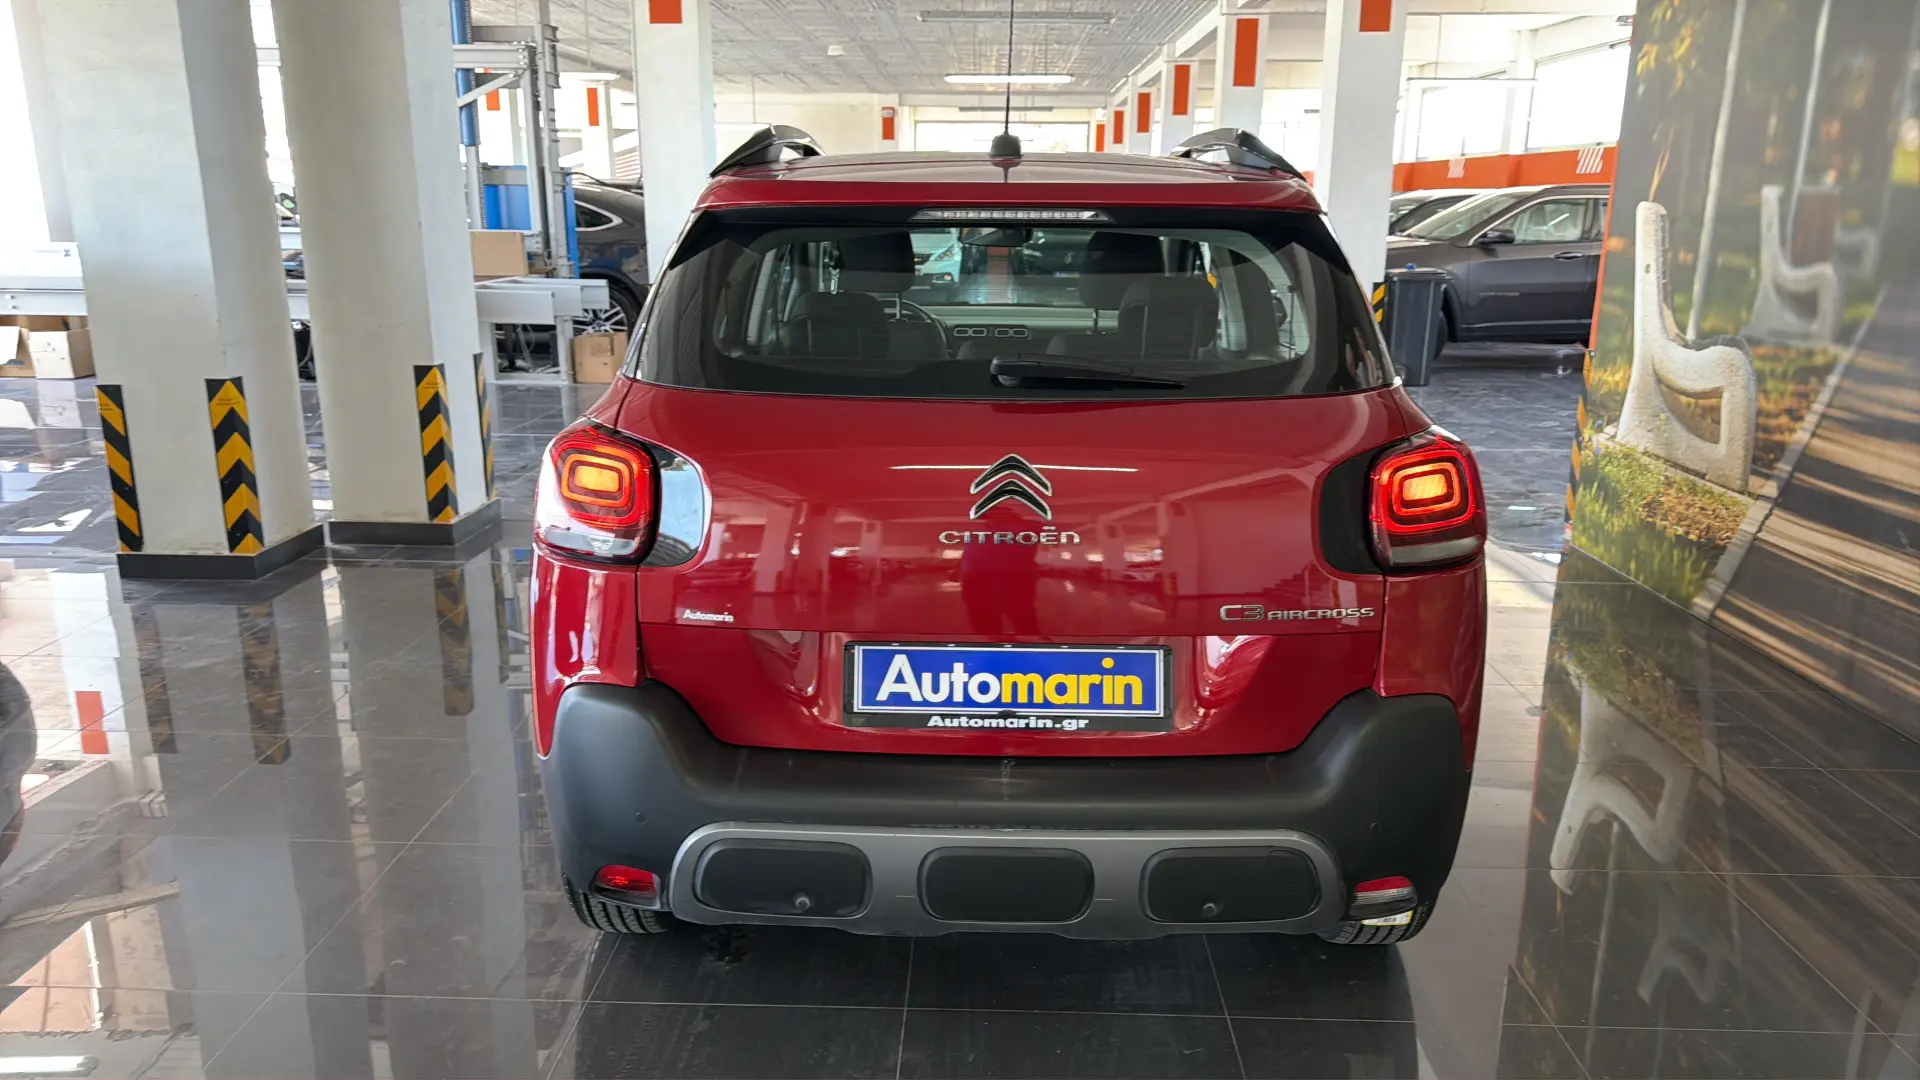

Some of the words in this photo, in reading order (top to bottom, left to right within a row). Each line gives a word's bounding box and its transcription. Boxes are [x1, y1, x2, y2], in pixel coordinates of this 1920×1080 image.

[1219, 604, 1265, 621] C3
[1267, 607, 1375, 621] AIRCROSS
[875, 654, 1143, 705] Automarin
[927, 715, 1089, 731] Automarin.gr
